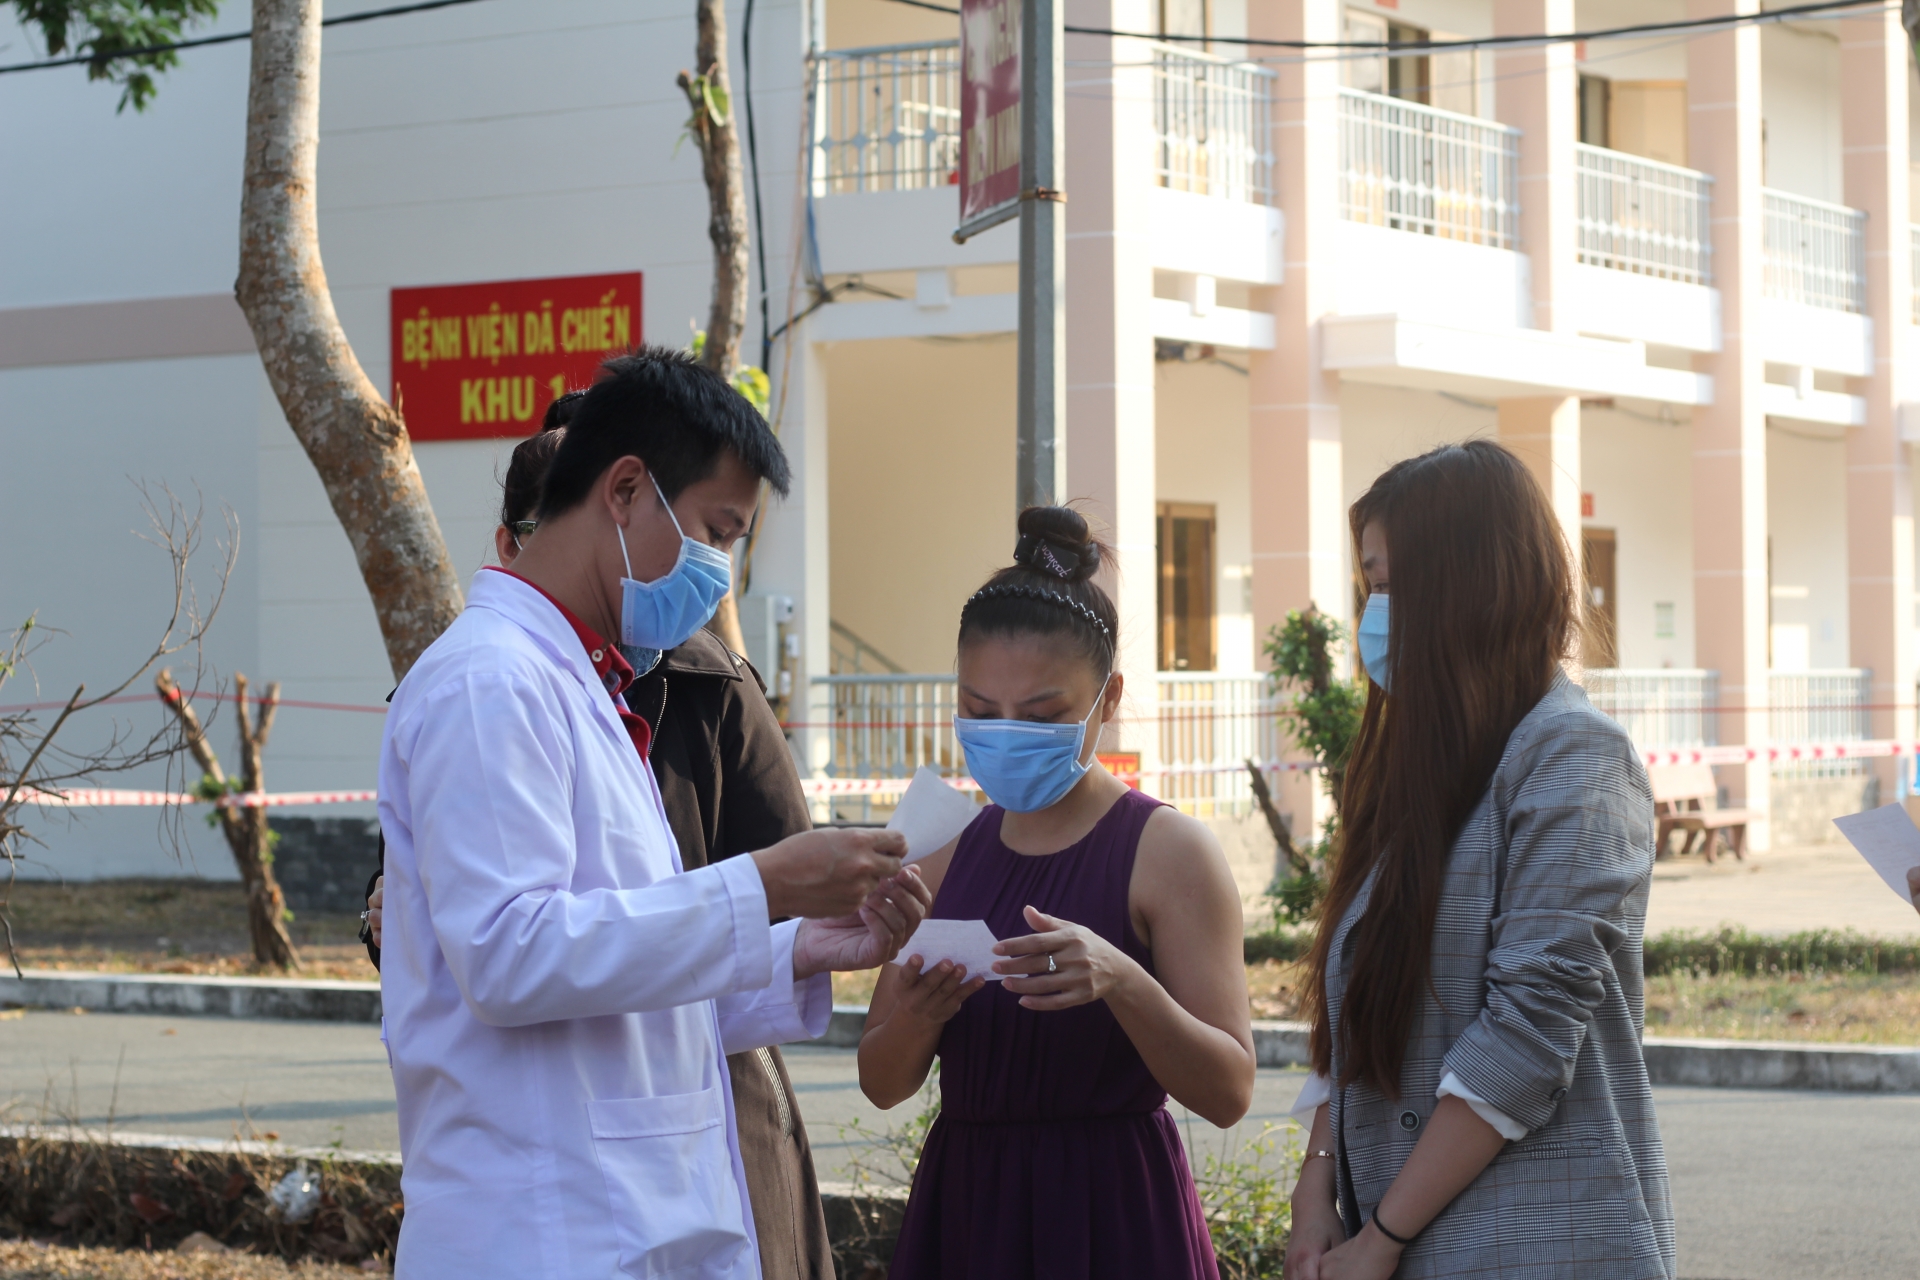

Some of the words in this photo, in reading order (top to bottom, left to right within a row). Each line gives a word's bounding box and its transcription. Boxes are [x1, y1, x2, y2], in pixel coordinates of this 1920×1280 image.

[402, 307, 461, 370] BỆNH
[467, 302, 518, 366] VIỆN
[525, 300, 555, 355] DÃ
[561, 289, 630, 353] CHIẾN
[461, 376, 535, 424] KHU
